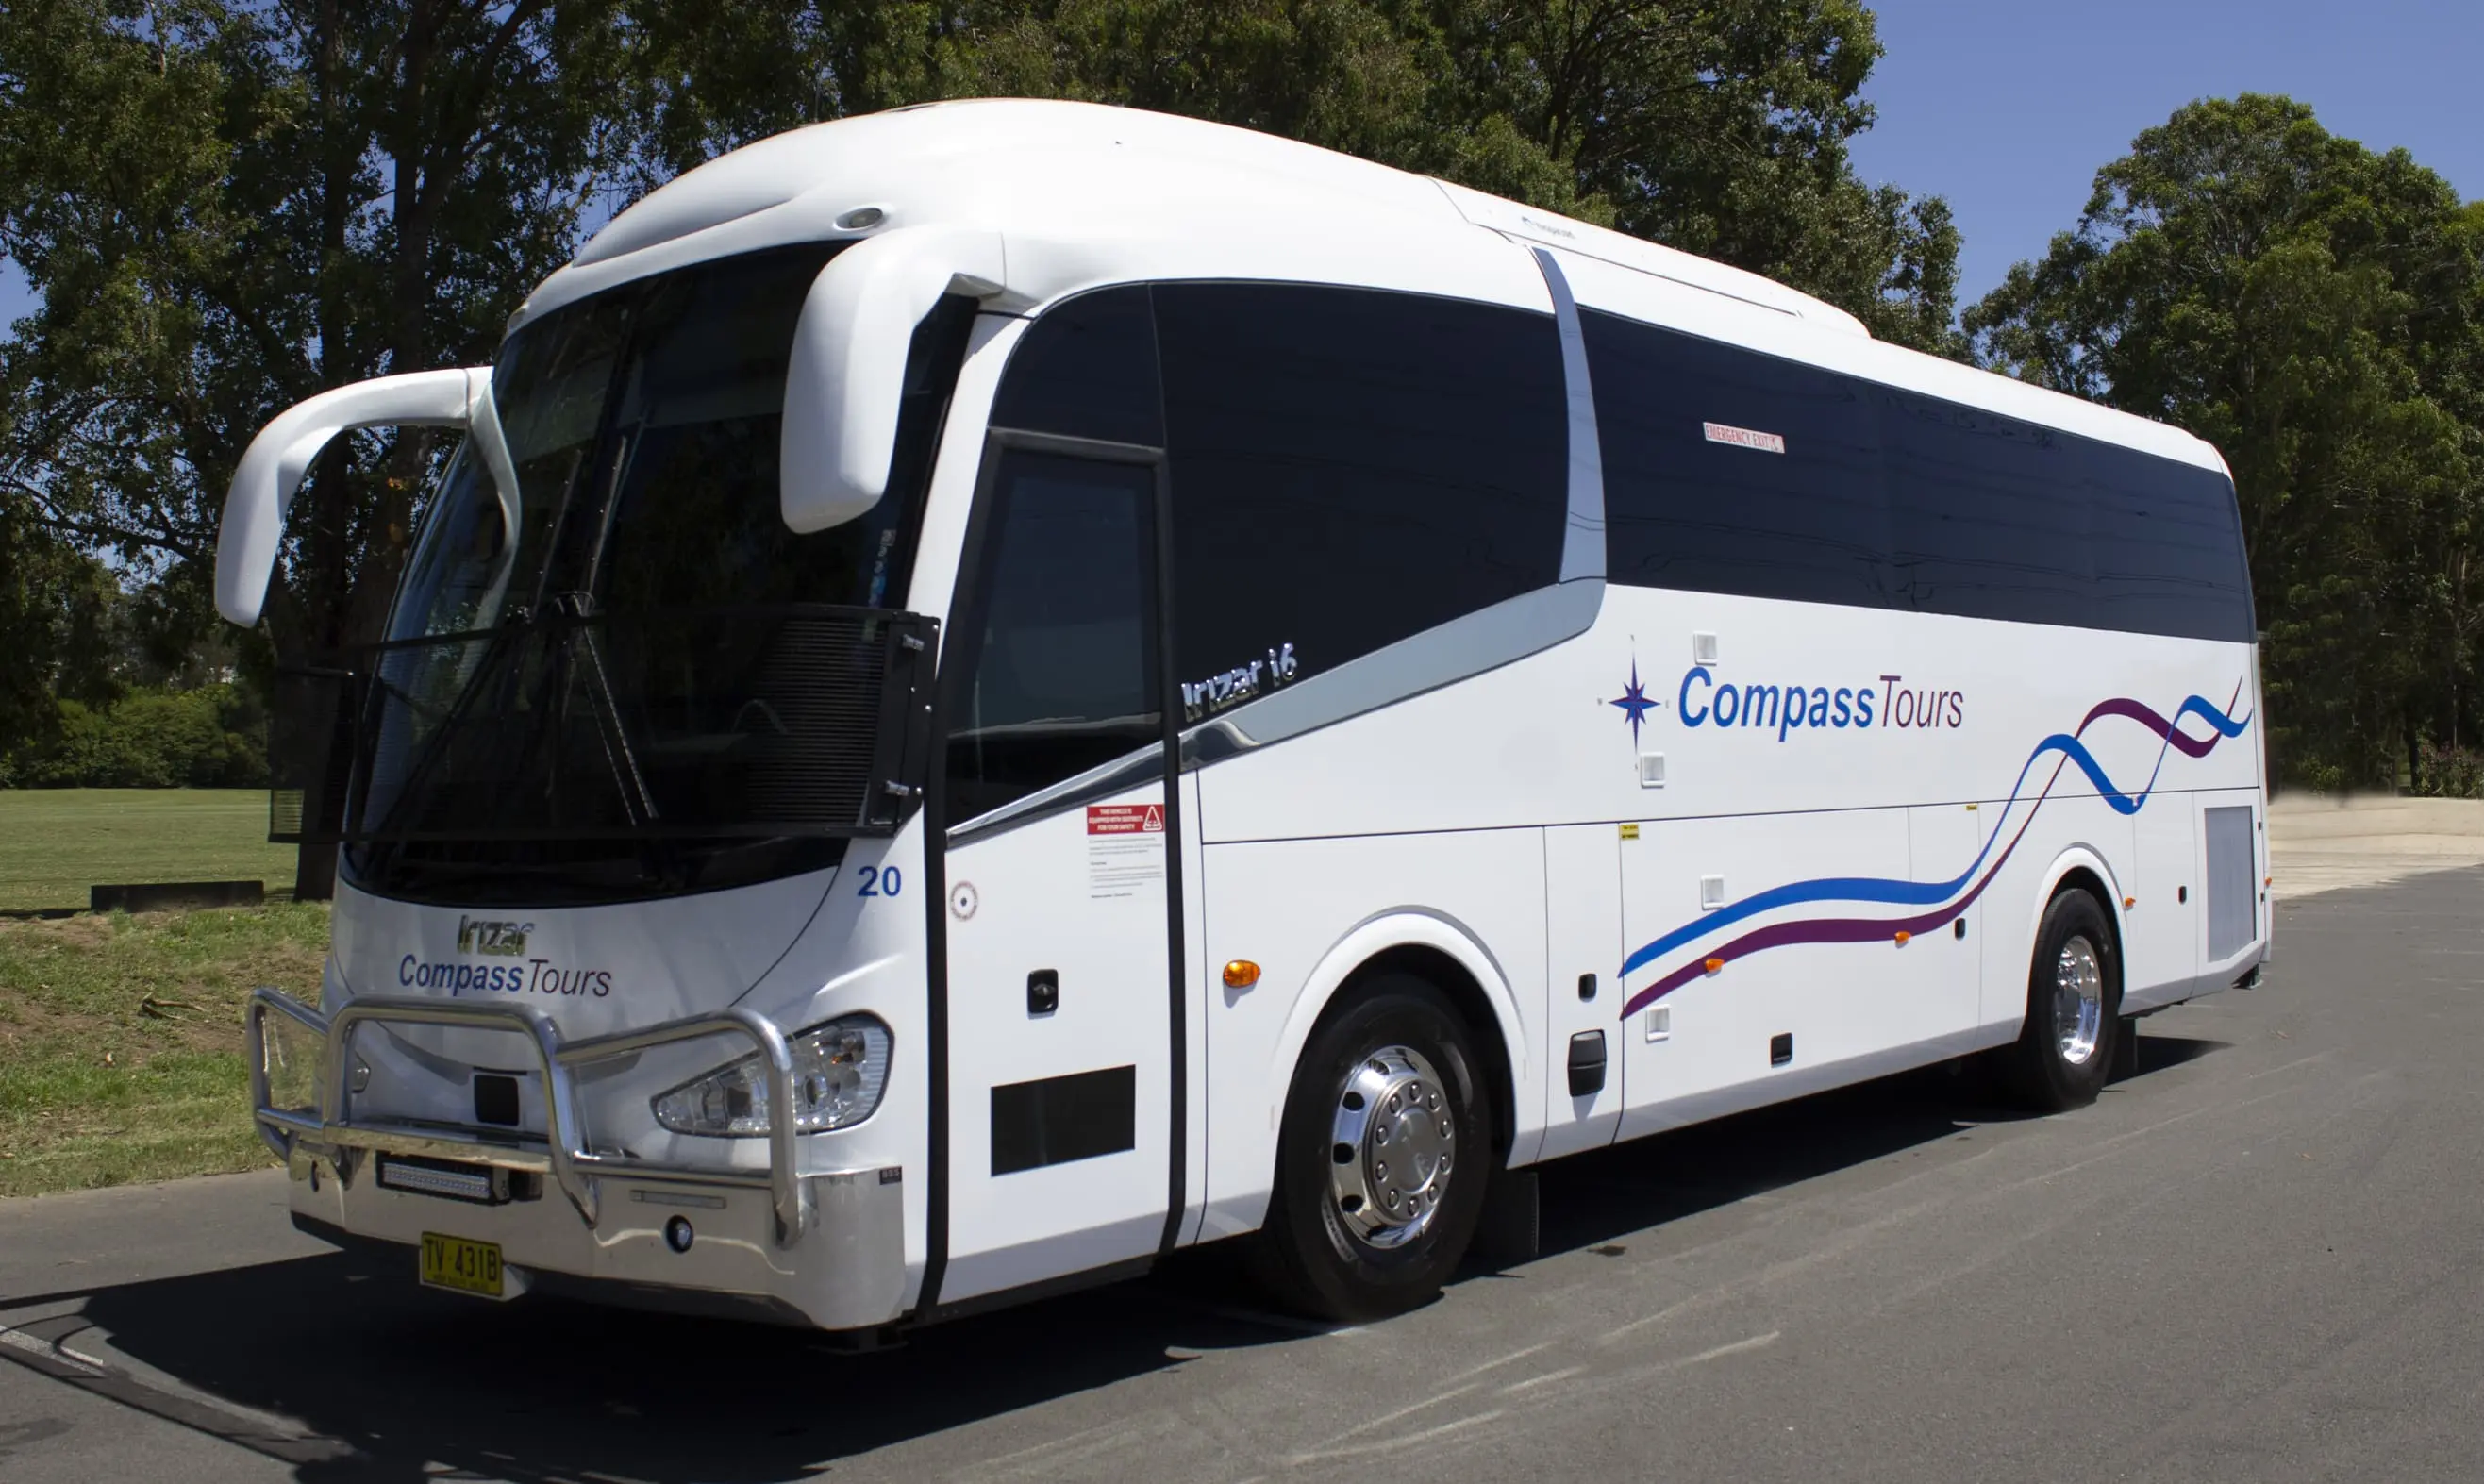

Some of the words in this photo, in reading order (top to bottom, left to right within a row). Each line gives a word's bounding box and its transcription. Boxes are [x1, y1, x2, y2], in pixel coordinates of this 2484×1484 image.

[1705, 424, 1752, 446] EMERGENCY
[1753, 432, 1771, 449] EXIT
[1181, 659, 1263, 723] Irizar
[1268, 642, 1298, 688] i6
[858, 866, 902, 897] 20
